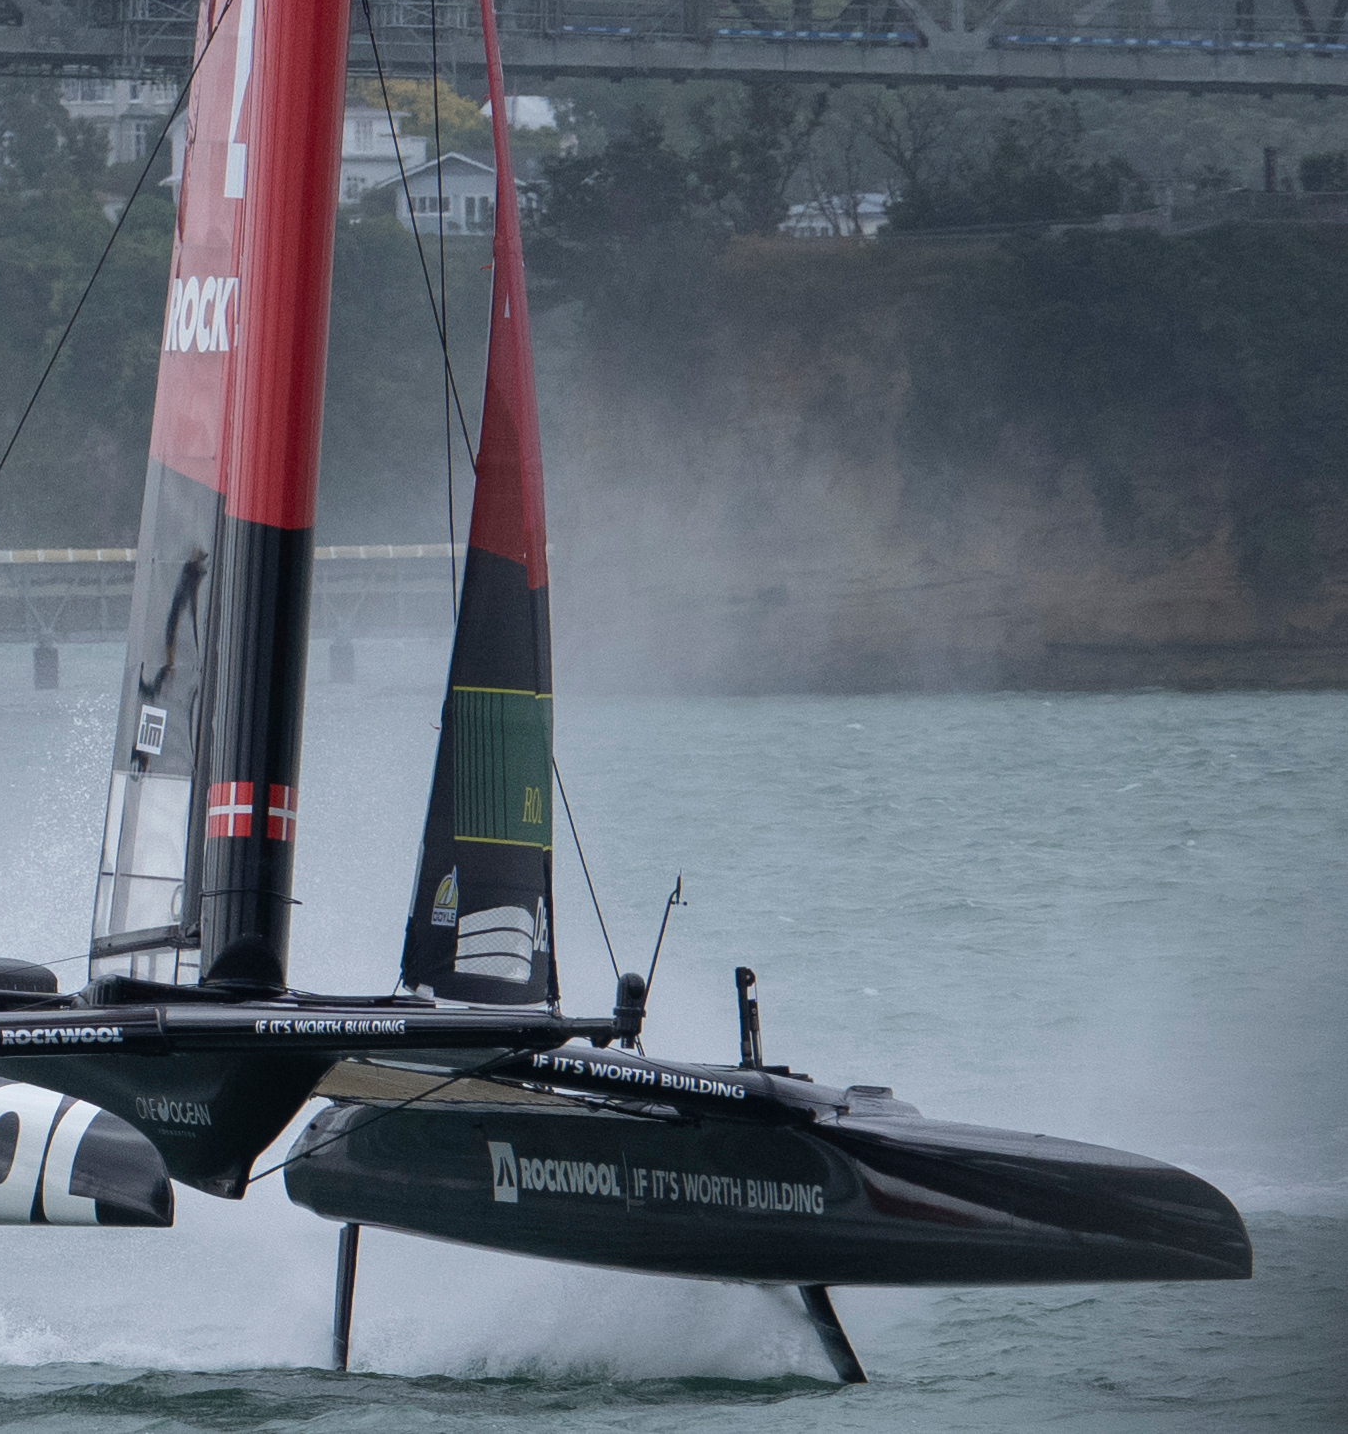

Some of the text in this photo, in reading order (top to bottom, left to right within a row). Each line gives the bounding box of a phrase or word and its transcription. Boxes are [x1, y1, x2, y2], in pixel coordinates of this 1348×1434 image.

[2, 1026, 124, 1045] ROCKWOOL
[255, 1020, 405, 1035] IF IT'S WORTH BUILDING
[532, 1053, 746, 1100] IF IT'S WORTH BUILDING
[135, 1096, 212, 1125] ONE OCEAN
[519, 1157, 621, 1197] ROCKWOOL
[633, 1168, 825, 1215] IF IT'S WORTH BUILDING
